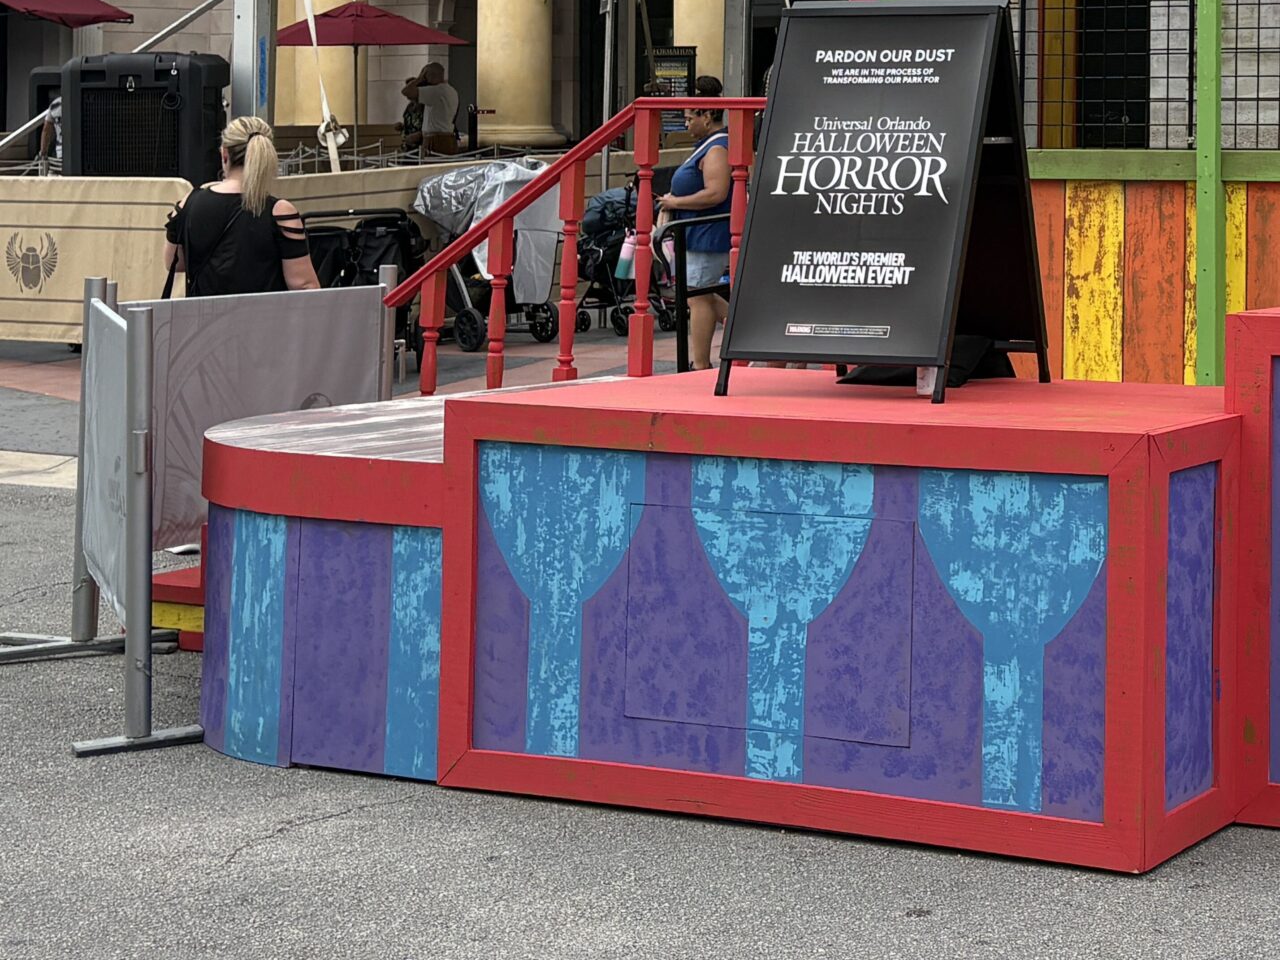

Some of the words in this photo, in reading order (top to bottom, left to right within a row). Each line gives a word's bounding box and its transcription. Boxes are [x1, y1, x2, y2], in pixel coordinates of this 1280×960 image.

[815, 50, 877, 63] PARDON
[880, 49, 912, 62] OUR
[914, 49, 955, 62] DUST
[831, 68, 844, 76] WE
[844, 68, 859, 76] ARE
[860, 68, 869, 76] IN
[870, 68, 885, 76] THE
[886, 68, 922, 76] PROCESS
[923, 68, 934, 76] OF
[884, 76, 902, 84] OUR
[902, 76, 923, 84] PARK
[813, 116, 873, 131] Universal
[877, 116, 931, 131] Orlando
[790, 132, 947, 154] HALLOWEEN
[770, 155, 949, 205] HORROR
[813, 192, 905, 215] NIGHTS
[793, 251, 814, 265] THE
[813, 251, 860, 265] WORLD'S
[860, 252, 906, 266] PREMIER
[780, 264, 866, 284] HALLOWEEN
[867, 266, 915, 285] EVENT
